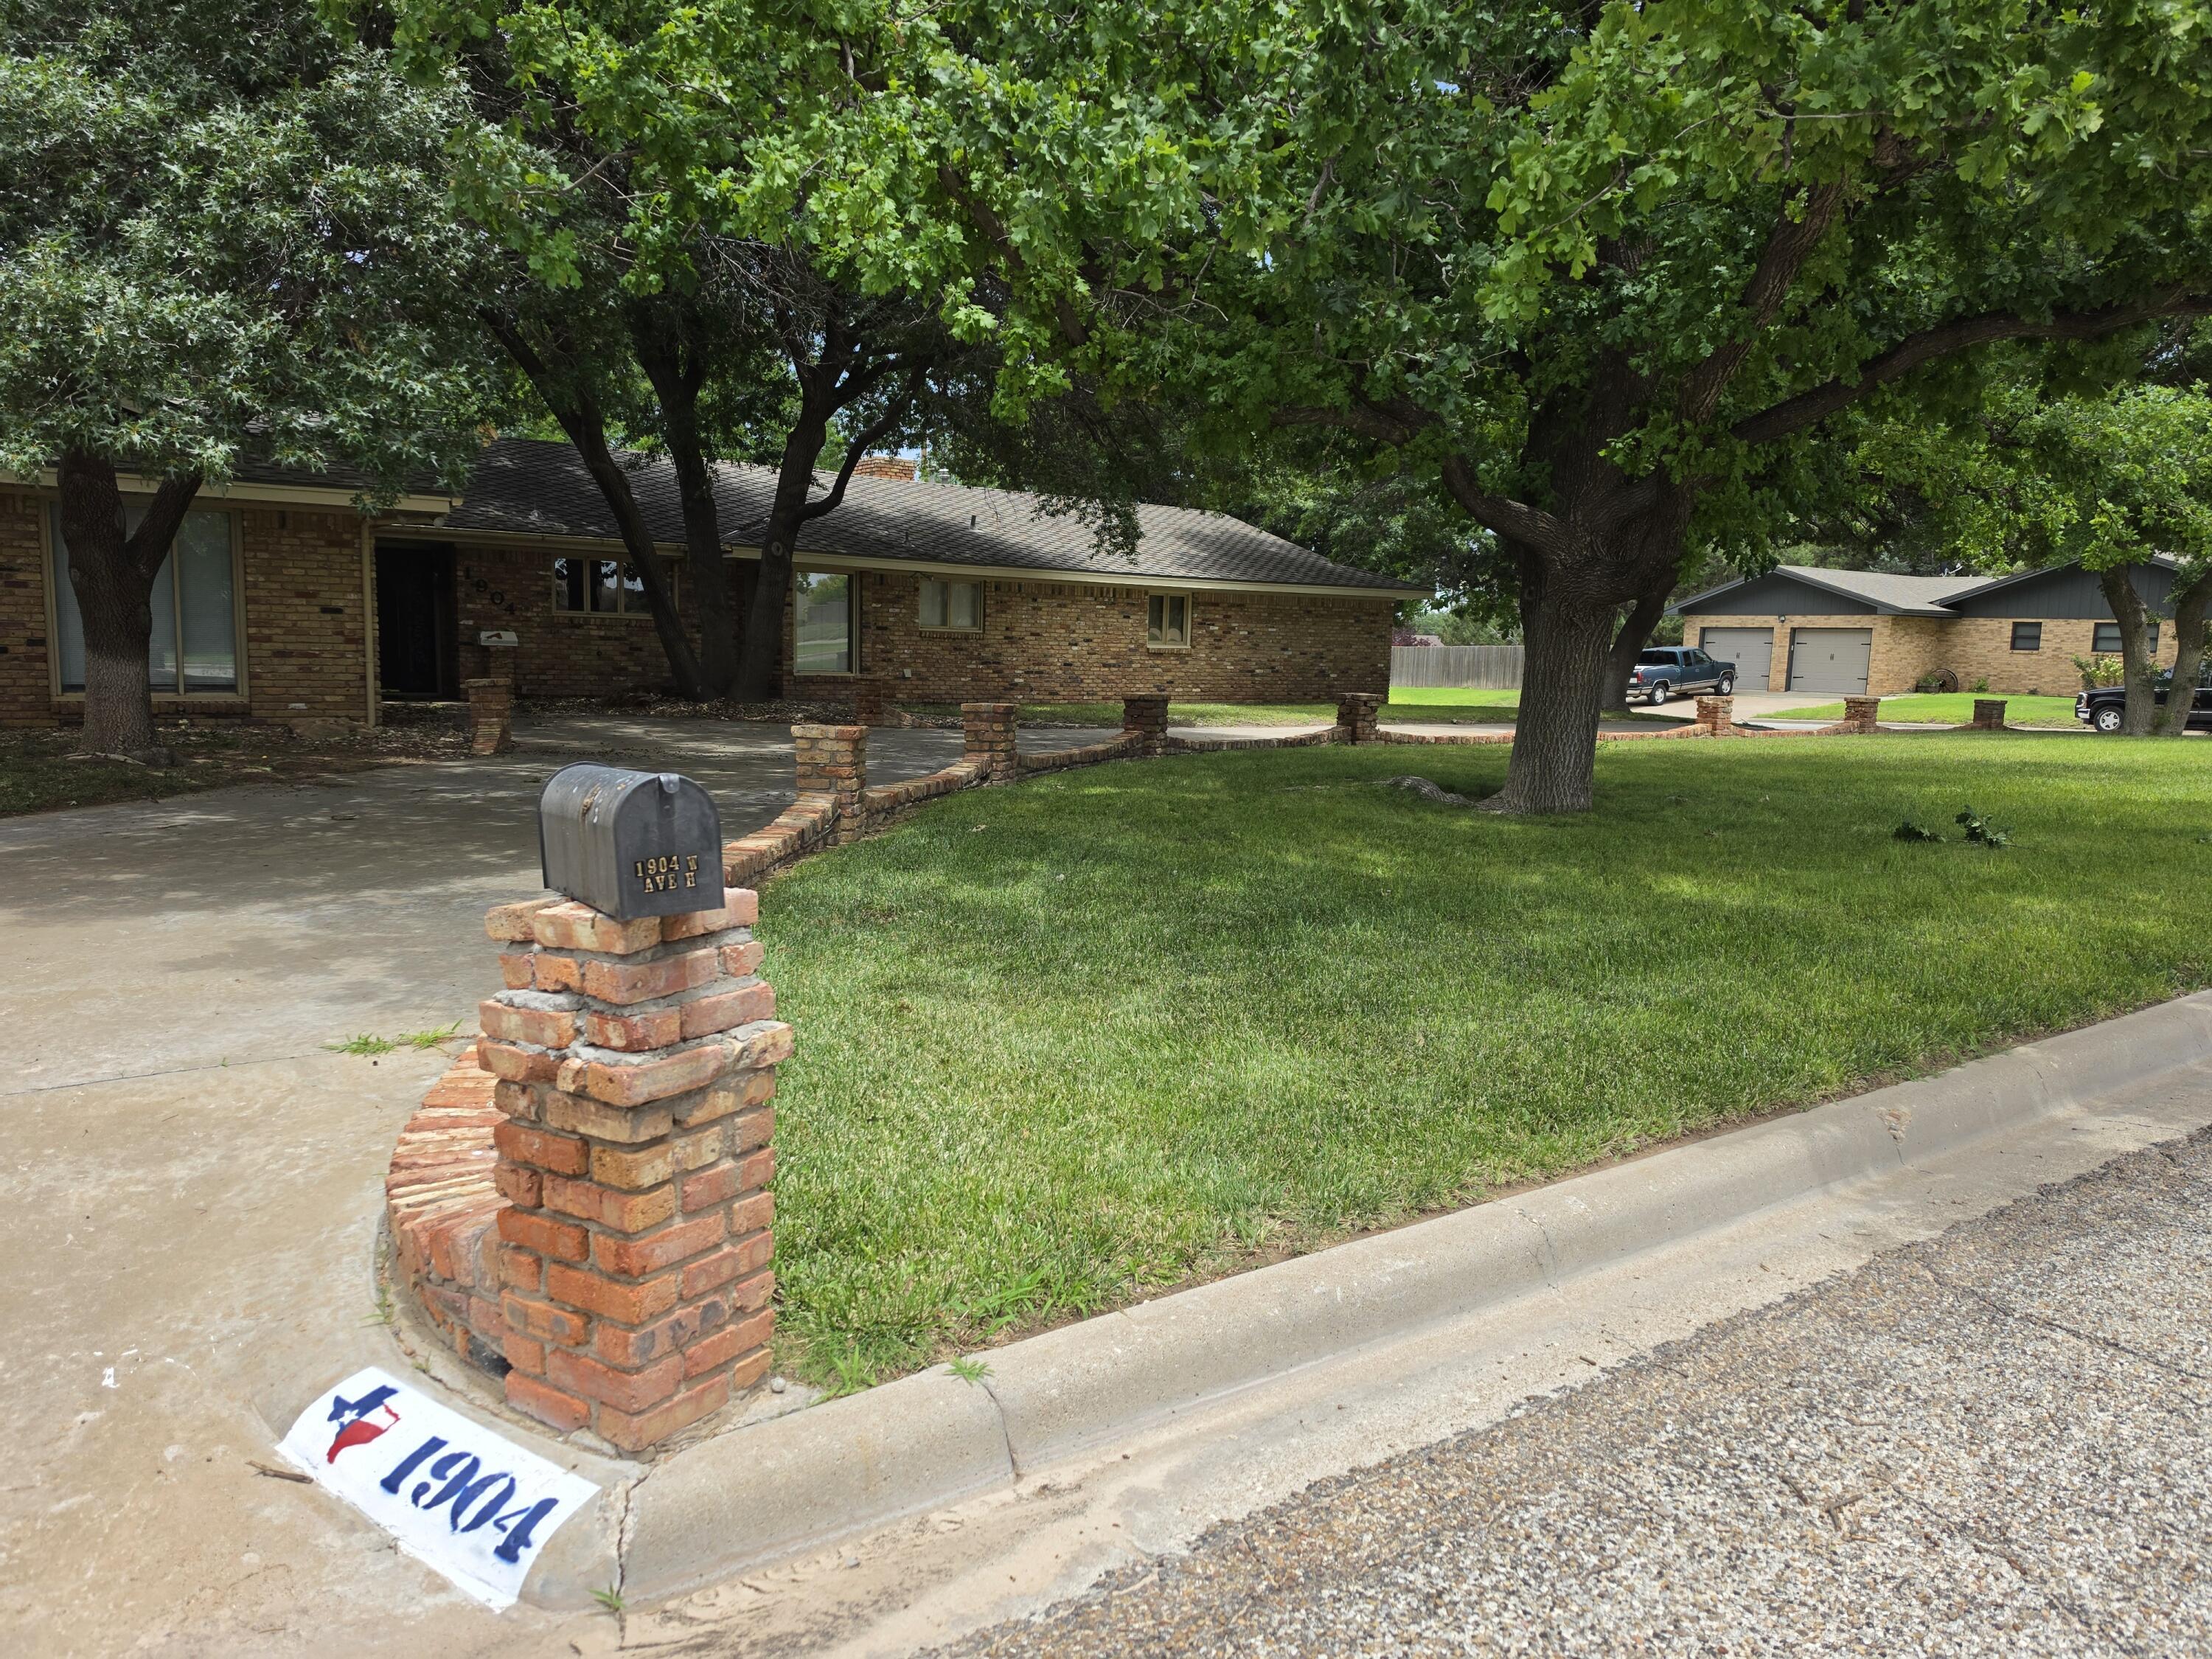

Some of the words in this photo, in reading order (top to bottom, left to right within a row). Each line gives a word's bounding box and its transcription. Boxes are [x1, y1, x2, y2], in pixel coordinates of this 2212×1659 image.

[465, 566, 515, 615] 1904
[636, 855, 679, 877] 1904
[686, 855, 698, 870] W
[644, 873, 678, 893] AVE
[684, 872, 697, 888] H
[380, 1436, 559, 1564] 1904
